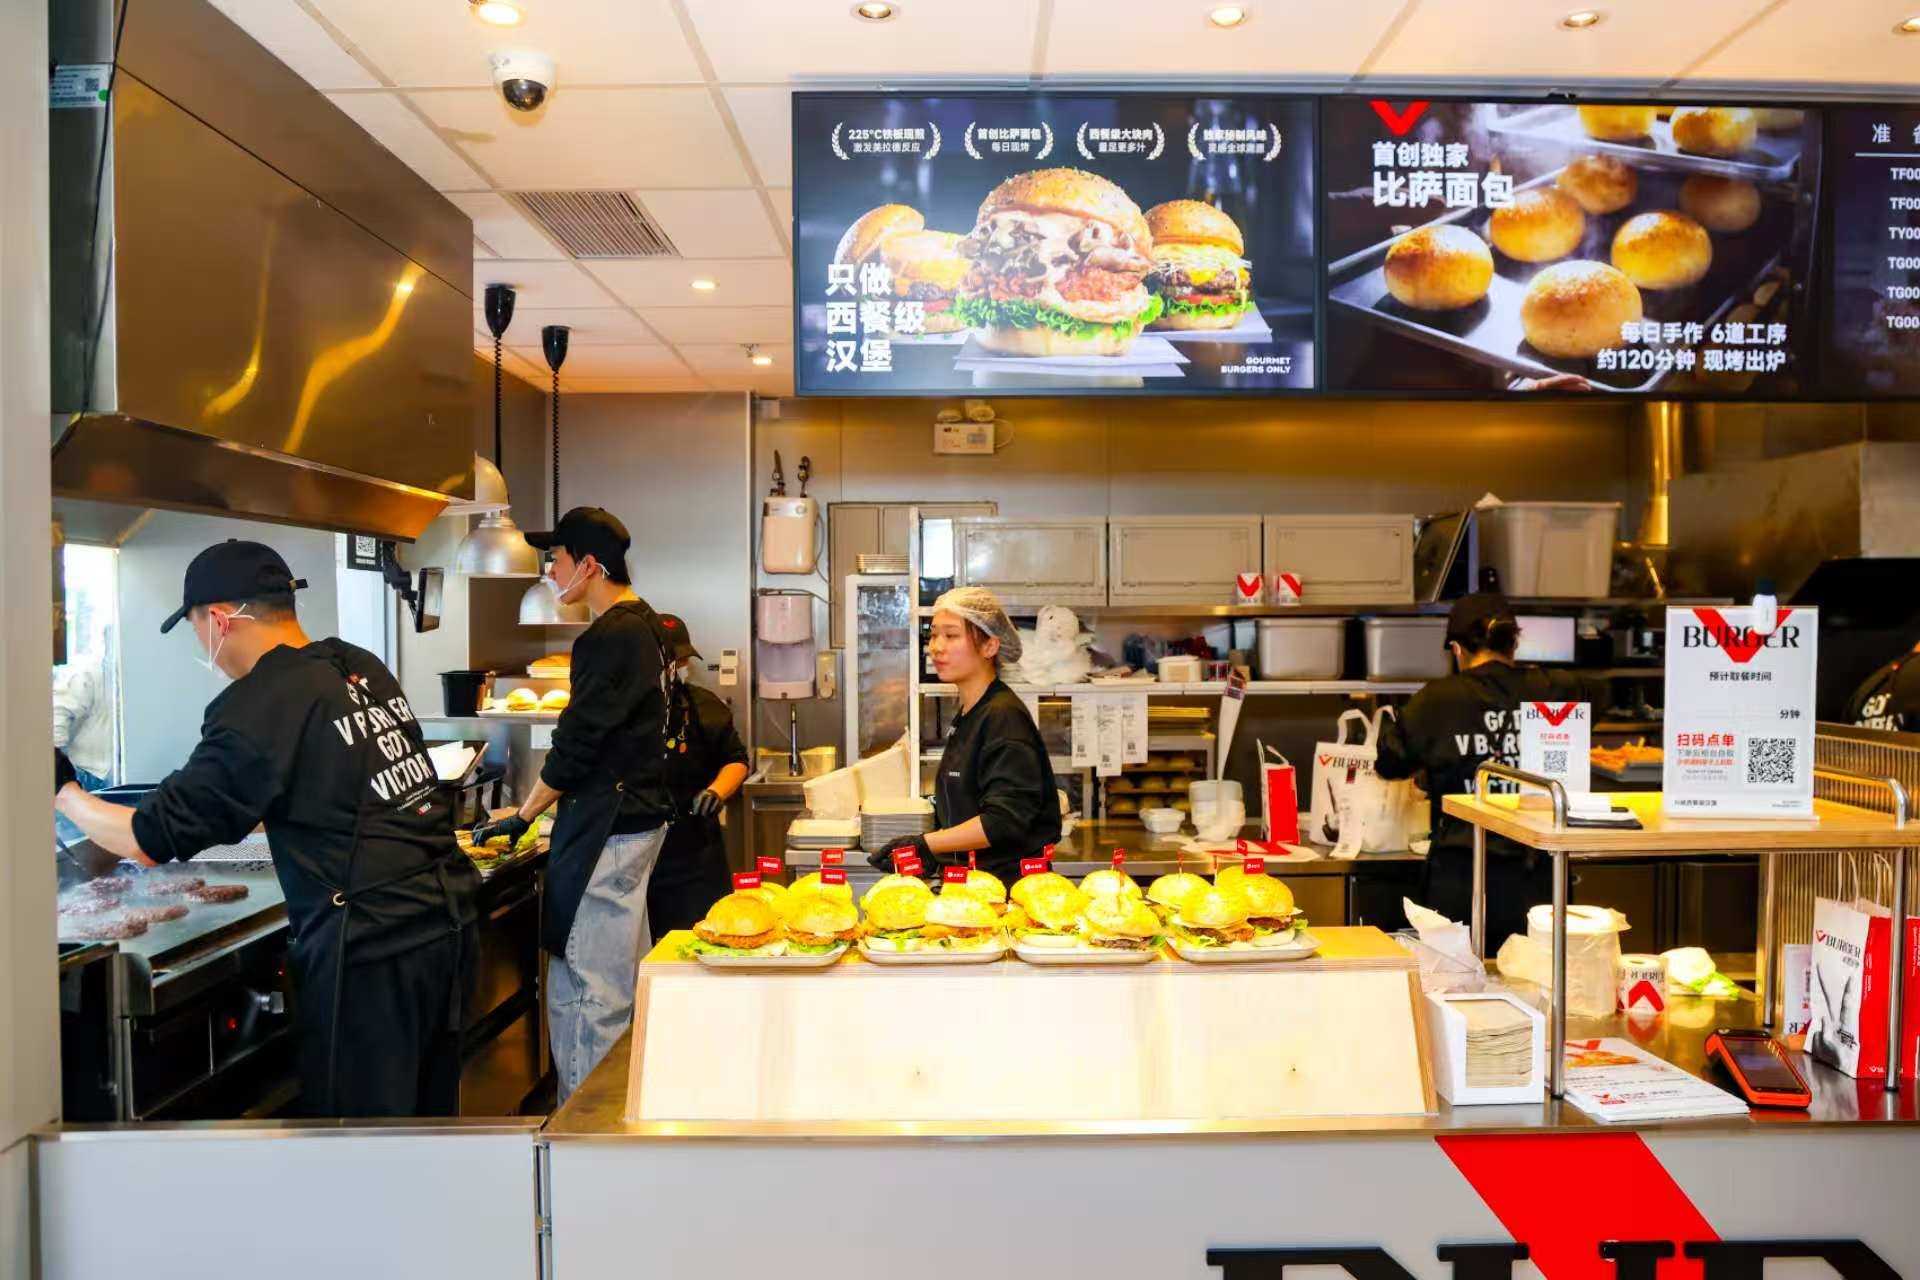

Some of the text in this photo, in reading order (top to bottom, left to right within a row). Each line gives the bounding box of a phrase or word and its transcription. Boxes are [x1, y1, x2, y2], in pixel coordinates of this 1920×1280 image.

[1372, 142, 1469, 168] 首创独家
[1372, 171, 1515, 208] 比萨面包
[825, 263, 892, 297] 只做
[825, 302, 927, 335] 西餐级
[1620, 321, 1787, 344] 每日手作 6道工序
[825, 339, 893, 373] 汉堡
[1245, 357, 1291, 365] GOURMET
[1597, 349, 1786, 372] 约120分钟 现烤出炉
[1220, 366, 1291, 374] BURGERS ONLY
[1709, 671, 1772, 681] 预计取餐时间
[1779, 709, 1801, 720] 分钟
[1455, 734, 1470, 756] V
[1677, 734, 1735, 748] 扫码点单
[371, 753, 434, 801] VICTOR
